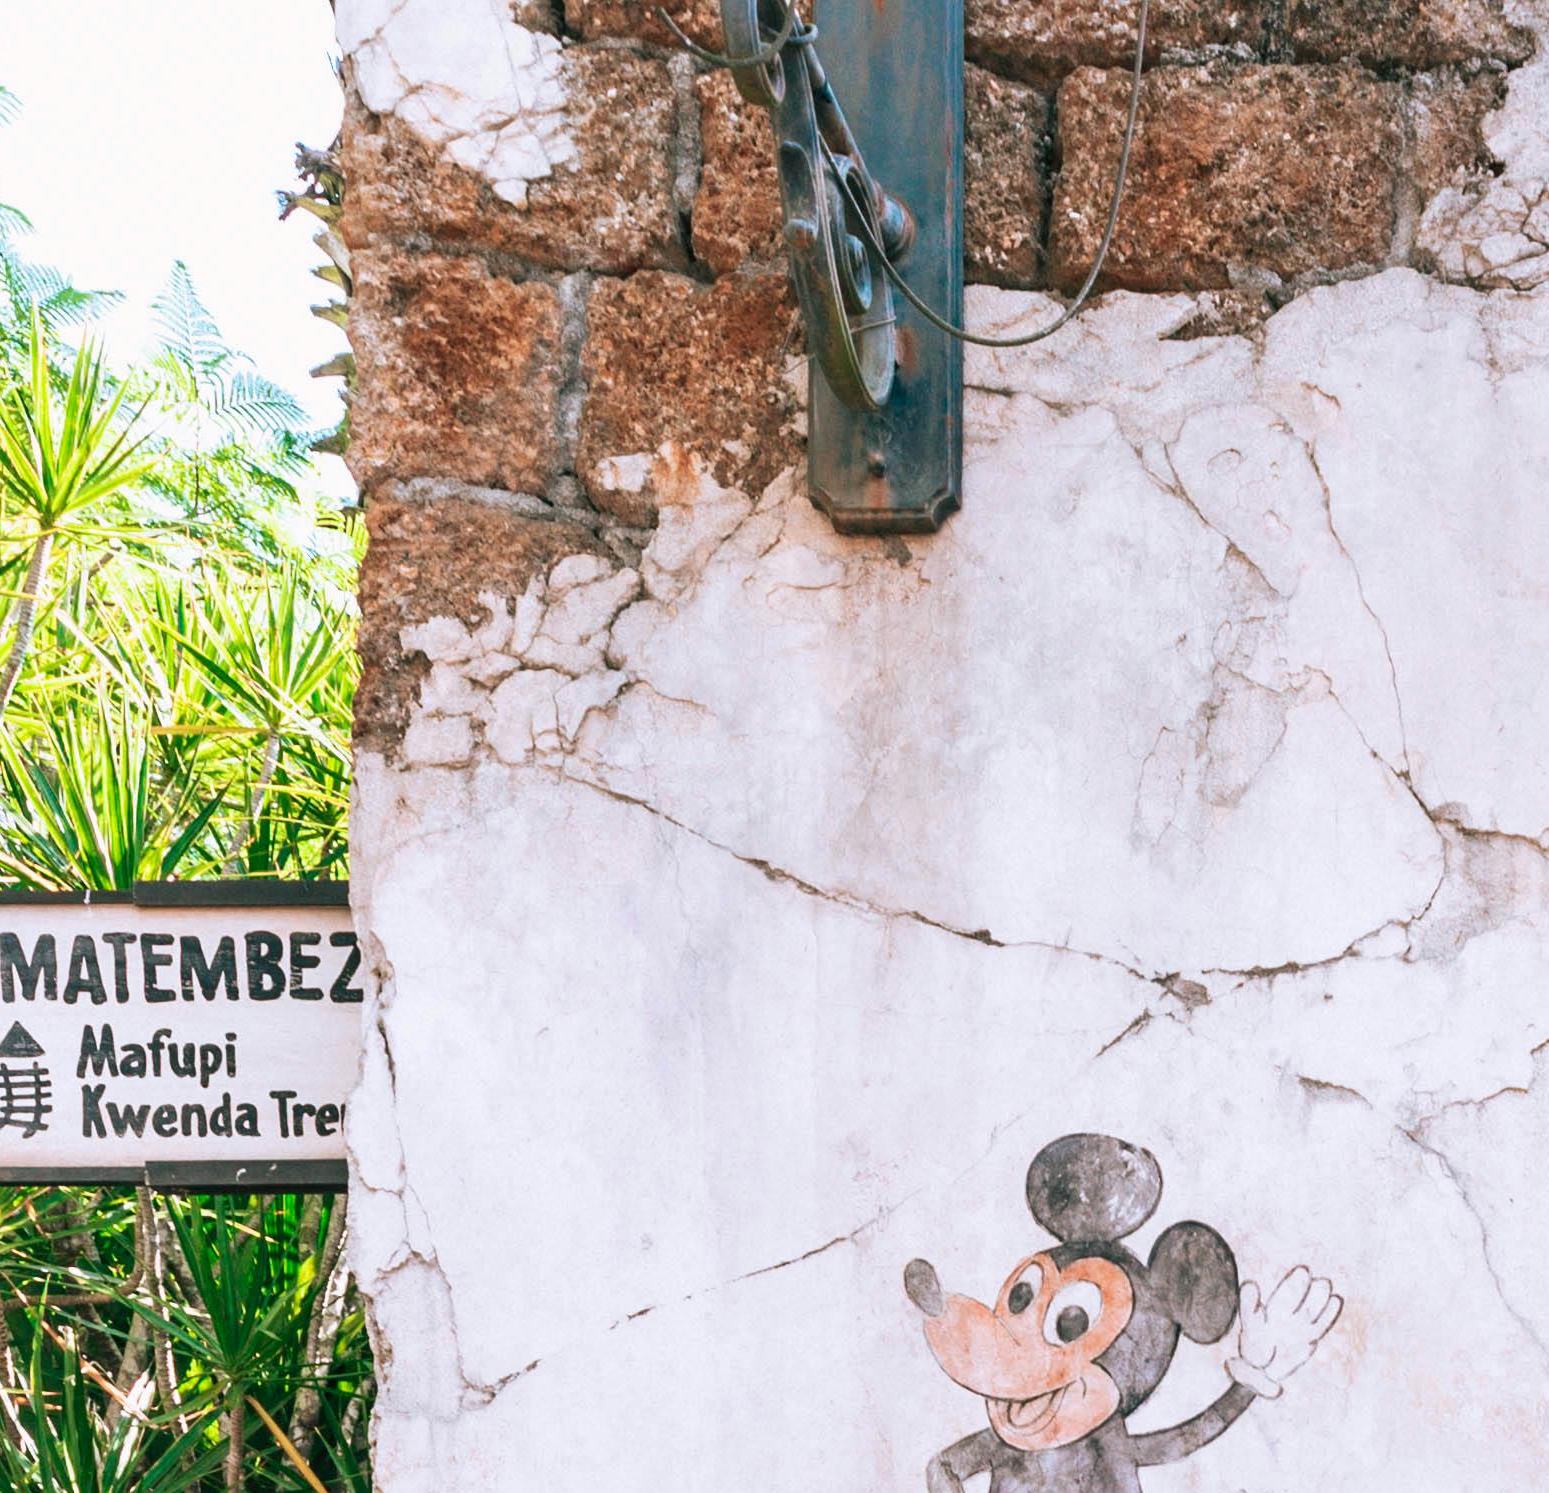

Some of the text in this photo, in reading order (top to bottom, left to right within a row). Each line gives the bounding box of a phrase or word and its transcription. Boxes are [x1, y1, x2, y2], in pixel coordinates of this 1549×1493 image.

[76, 1022, 238, 1089] Mafupi
[81, 1083, 346, 1139] Kwenda Tre
